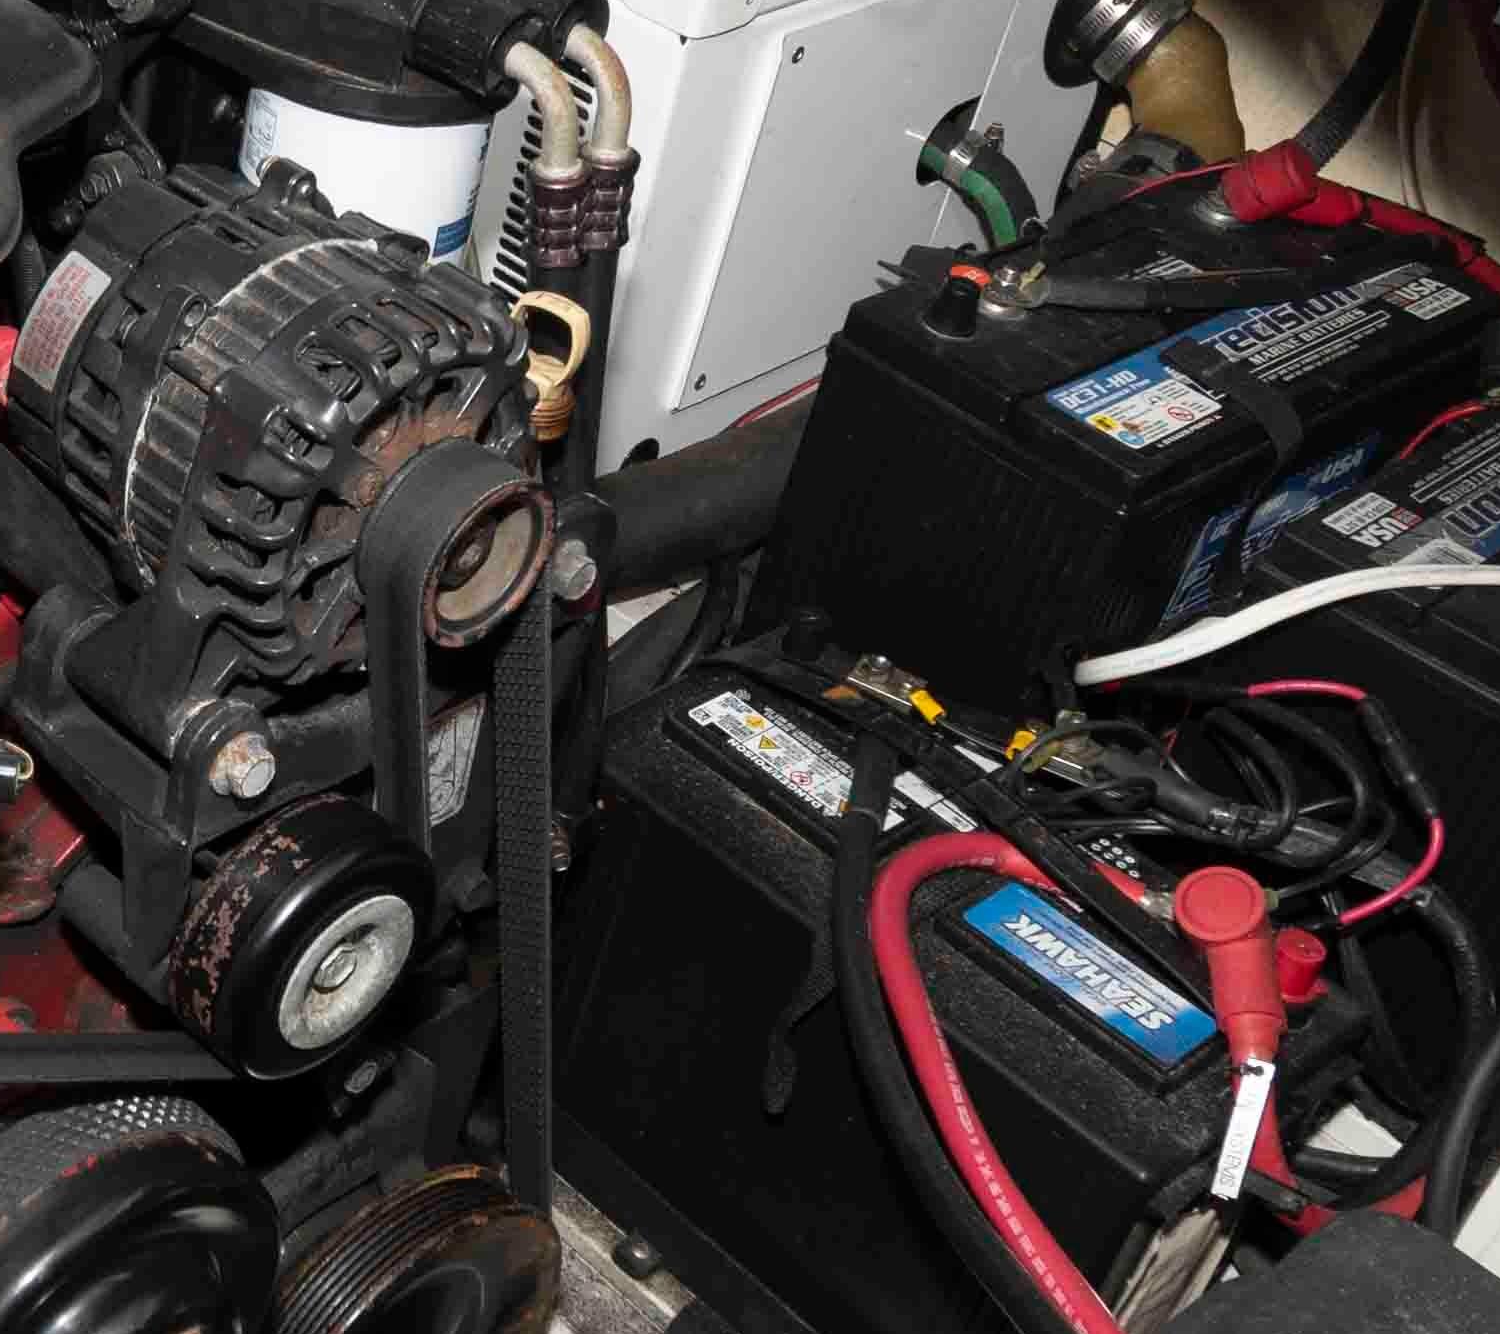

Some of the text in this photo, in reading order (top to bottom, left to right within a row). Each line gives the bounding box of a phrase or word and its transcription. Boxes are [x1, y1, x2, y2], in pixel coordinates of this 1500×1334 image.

[1400, 276, 1445, 304] USA
[1247, 334, 1306, 368] MARINE
[1300, 307, 1369, 344] BATTERIES
[1351, 514, 1406, 550] USA
[1001, 913, 1175, 1034] SEAHAWK
